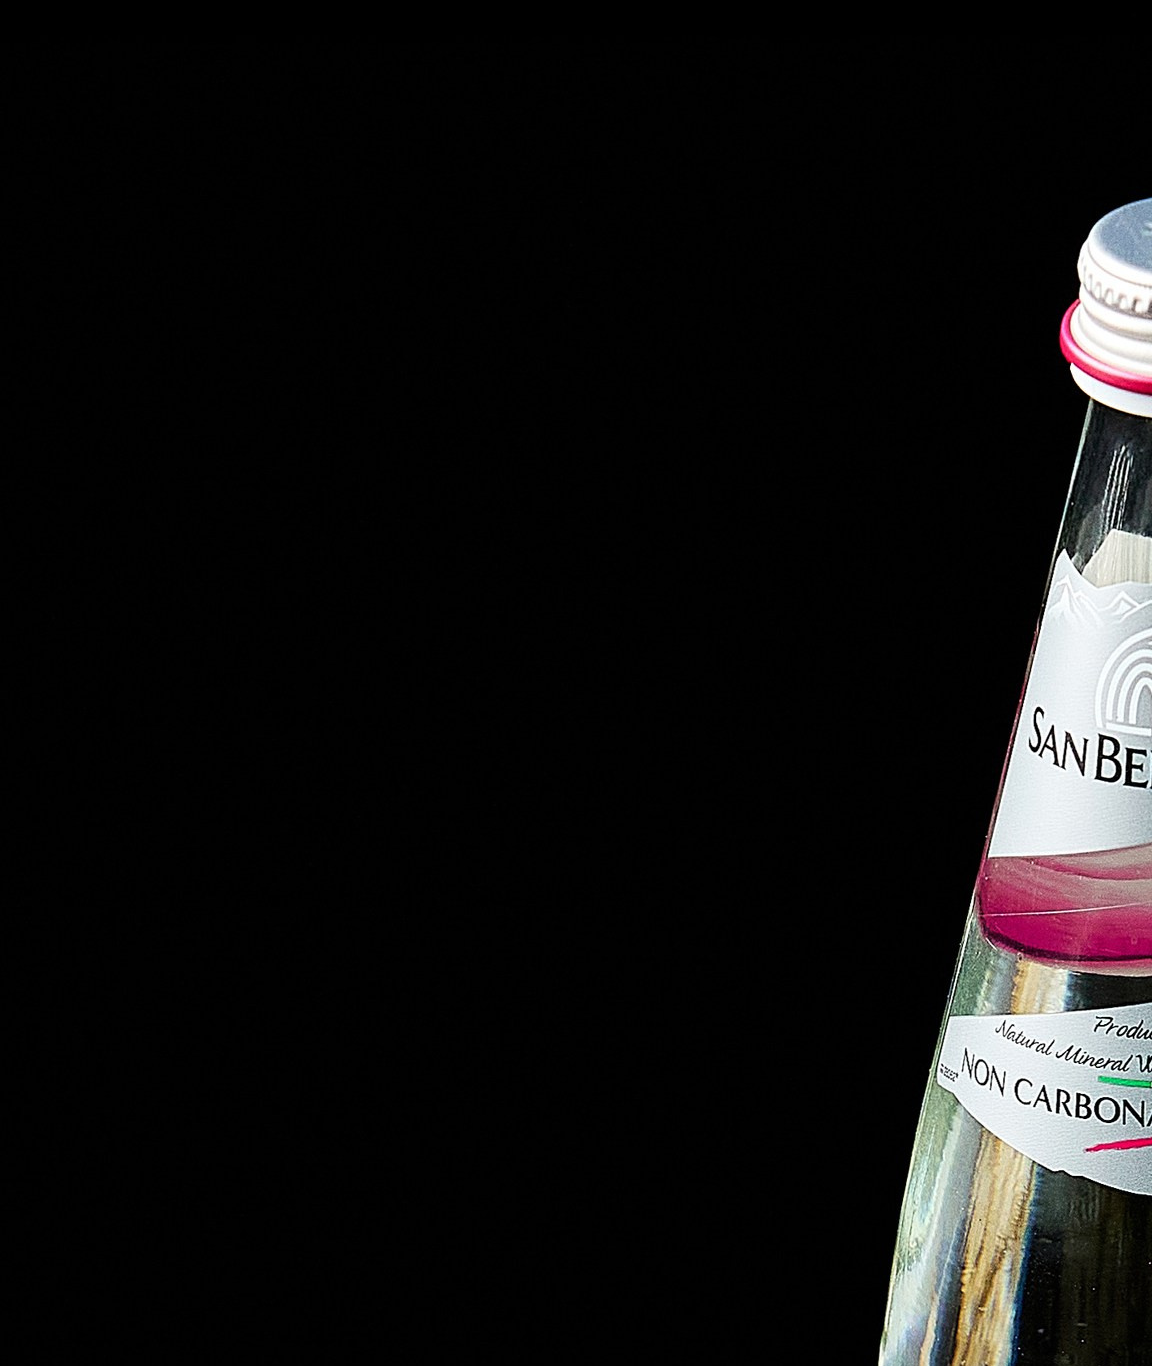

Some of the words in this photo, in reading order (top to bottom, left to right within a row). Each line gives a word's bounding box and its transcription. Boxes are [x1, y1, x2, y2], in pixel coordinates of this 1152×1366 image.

[1028, 706, 1088, 777] SAN
[961, 1047, 1007, 1097] NON
[994, 1020, 1055, 1056] Natural
[1055, 1044, 1133, 1072] Mineral
